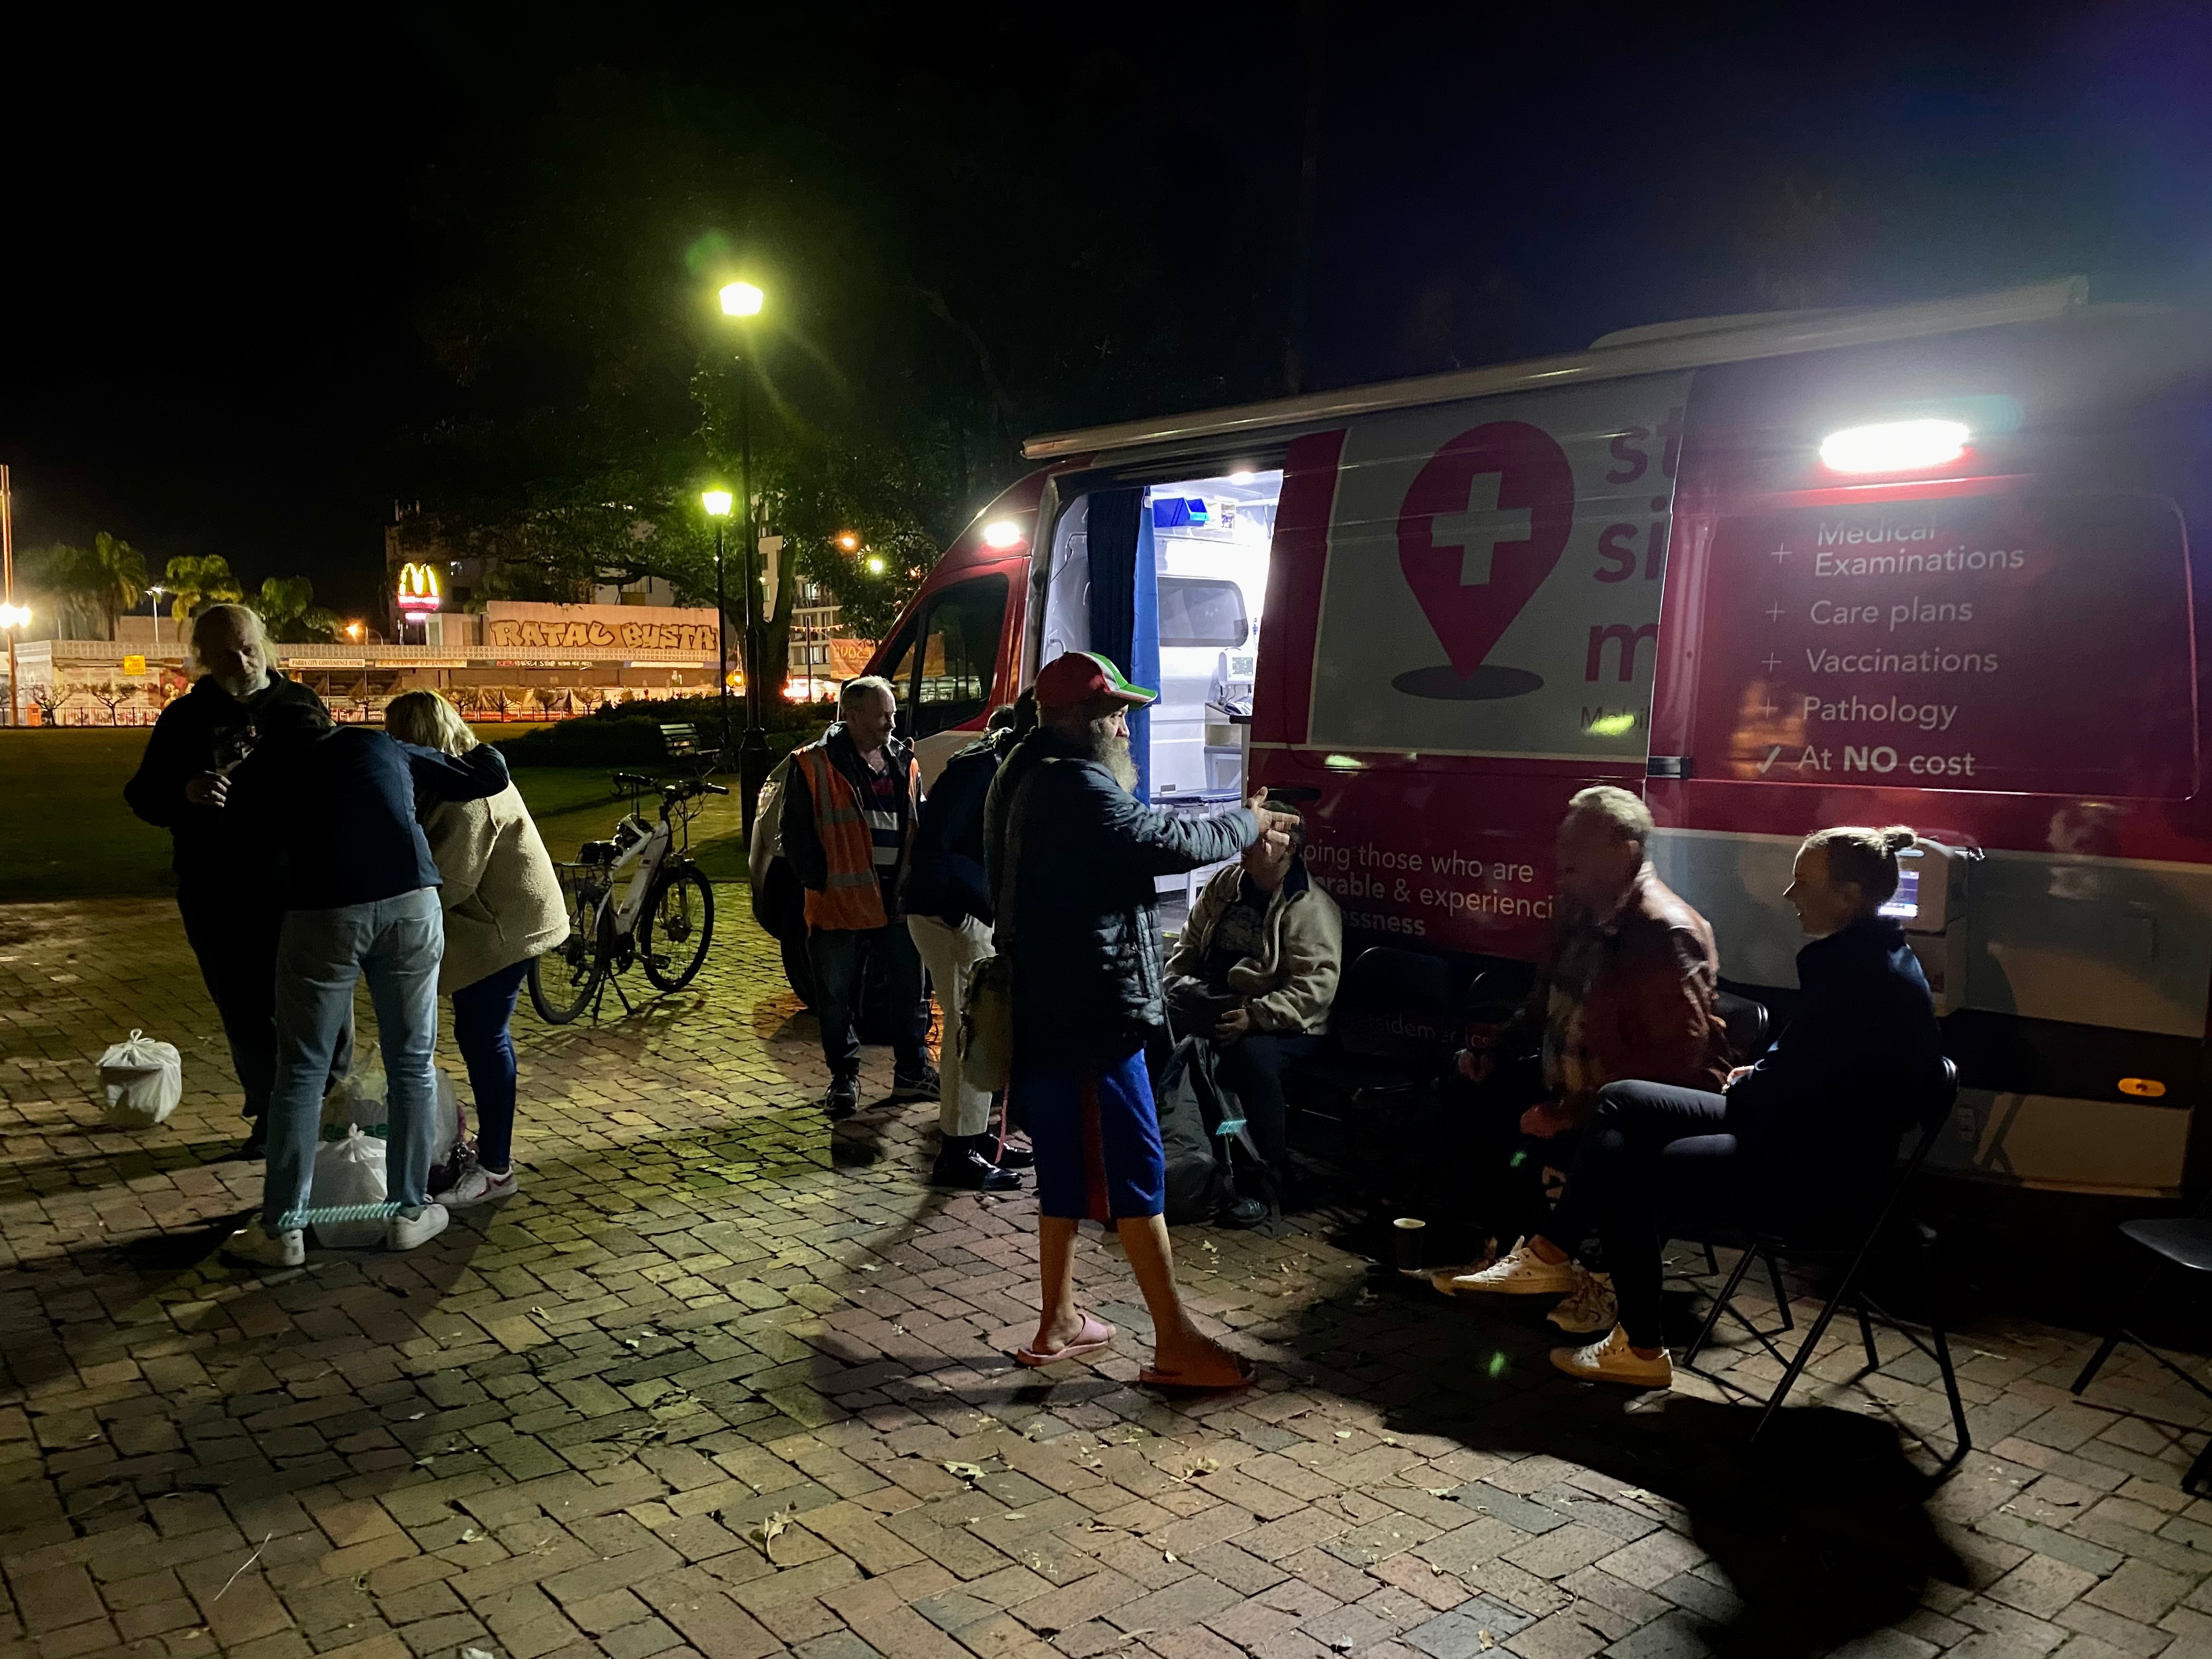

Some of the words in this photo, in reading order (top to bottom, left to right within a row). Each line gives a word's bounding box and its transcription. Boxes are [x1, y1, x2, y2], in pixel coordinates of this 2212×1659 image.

[1817, 515, 1936, 546] Medical
[1815, 545, 2024, 577] Examinations
[1810, 600, 1878, 624] Care
[1890, 596, 1974, 632] plans
[1806, 647, 1999, 673] Vaccinations
[1803, 695, 1959, 731] Pathology
[1797, 745, 1832, 771] At
[1843, 746, 1898, 773] NO
[1909, 752, 1976, 776] cost
[1358, 841, 1423, 871] those
[1431, 849, 1483, 878] who
[1493, 861, 1534, 883] are
[1393, 878, 1411, 902] &
[1419, 888, 1554, 919] experienci
